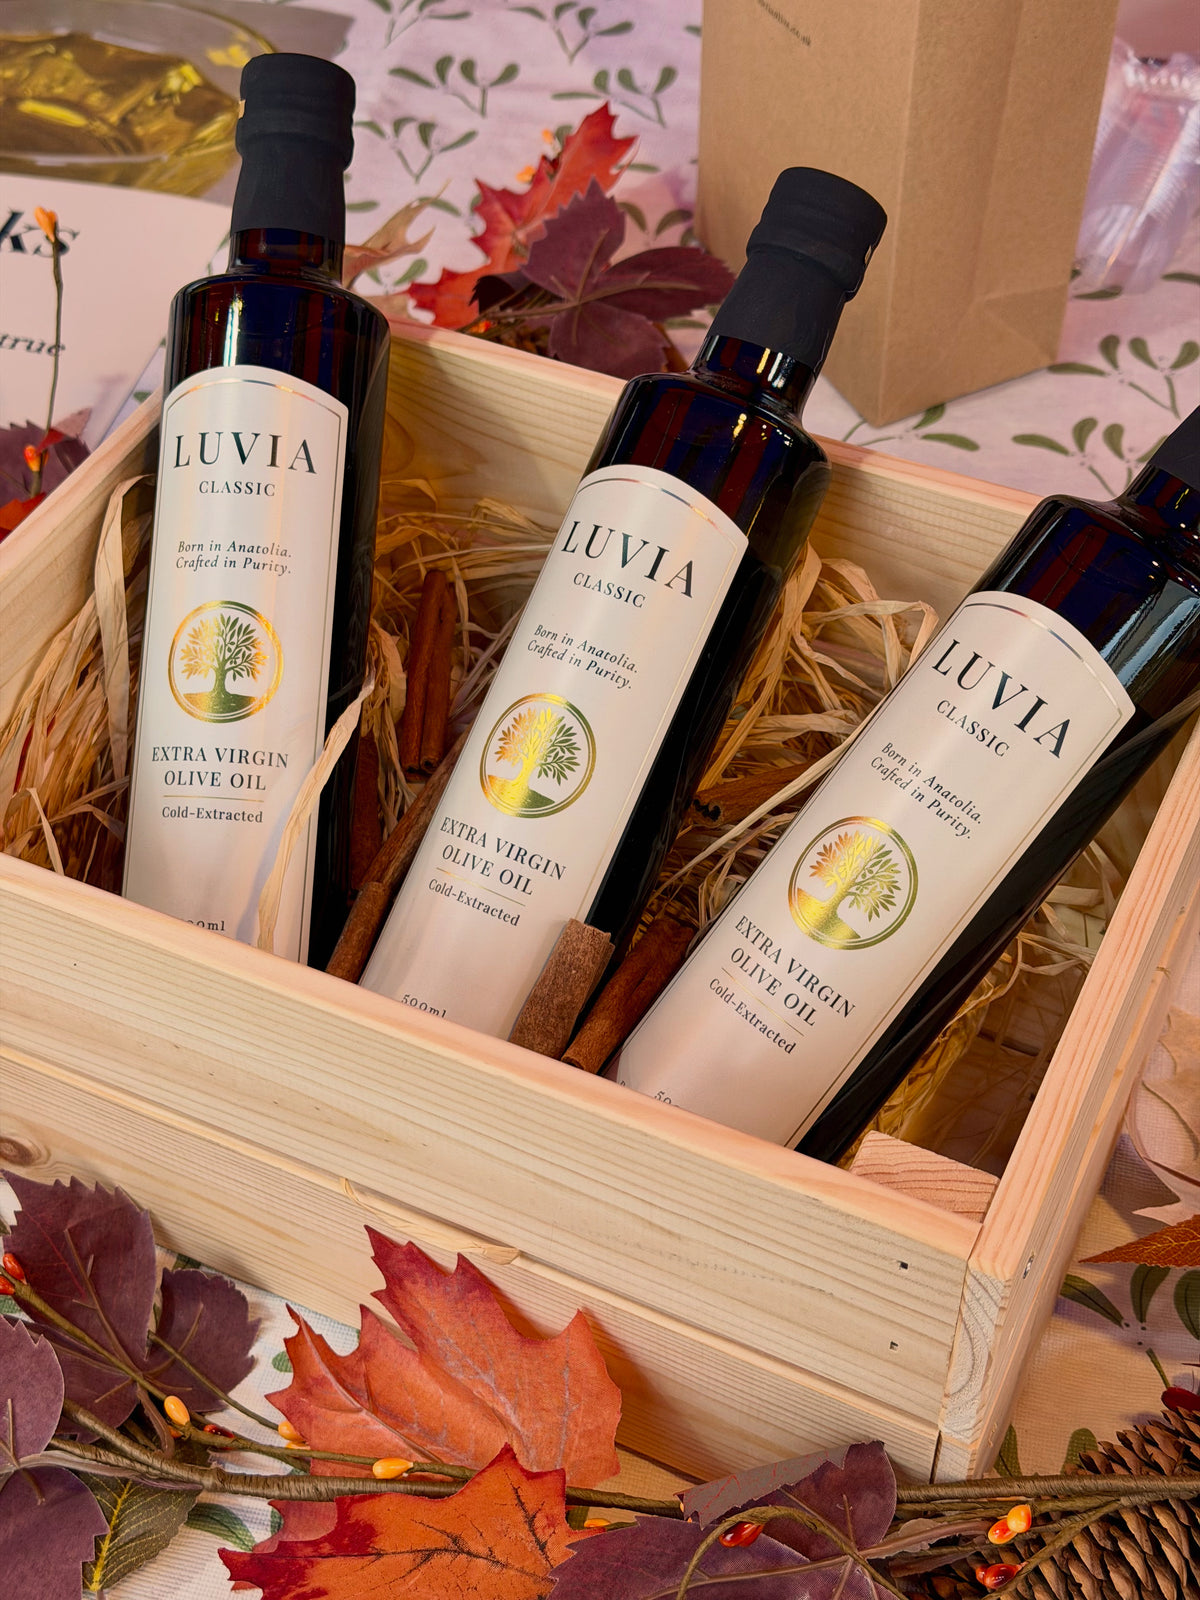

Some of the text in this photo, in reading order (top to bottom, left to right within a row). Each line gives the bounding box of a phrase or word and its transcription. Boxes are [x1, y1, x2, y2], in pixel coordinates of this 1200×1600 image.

[174, 431, 317, 474] LUVIA
[199, 480, 276, 497] CLASSIC
[175, 554, 292, 577] Crafted in Purity.
[177, 540, 292, 558] Born in Anatolia.
[561, 521, 694, 598] LUVIA
[573, 572, 646, 608] CLASSIC
[527, 639, 632, 690] Crafted in Purity.
[534, 624, 639, 673] Born in Anatolia.
[931, 638, 1071, 759] LUVIA
[936, 699, 1010, 757] CLASSIC
[151, 746, 289, 769] EXTRA VIRGIN
[164, 770, 267, 791] OLIVE OIL
[870, 756, 971, 839] Crafted in Purity.
[881, 742, 982, 824] Born in Anatolia.
[161, 806, 264, 823] Cold-Extracted
[439, 816, 567, 880] EXTRA VIRGIN
[441, 844, 534, 896] OLIVE OIL
[428, 878, 521, 926] Cold-Extracted
[730, 946, 818, 1027] OLIVE OIL
[734, 915, 857, 1019] EXTRA VIRGIN
[400, 993, 447, 1018] 500ml
[708, 978, 797, 1055] Cold-Extracted
